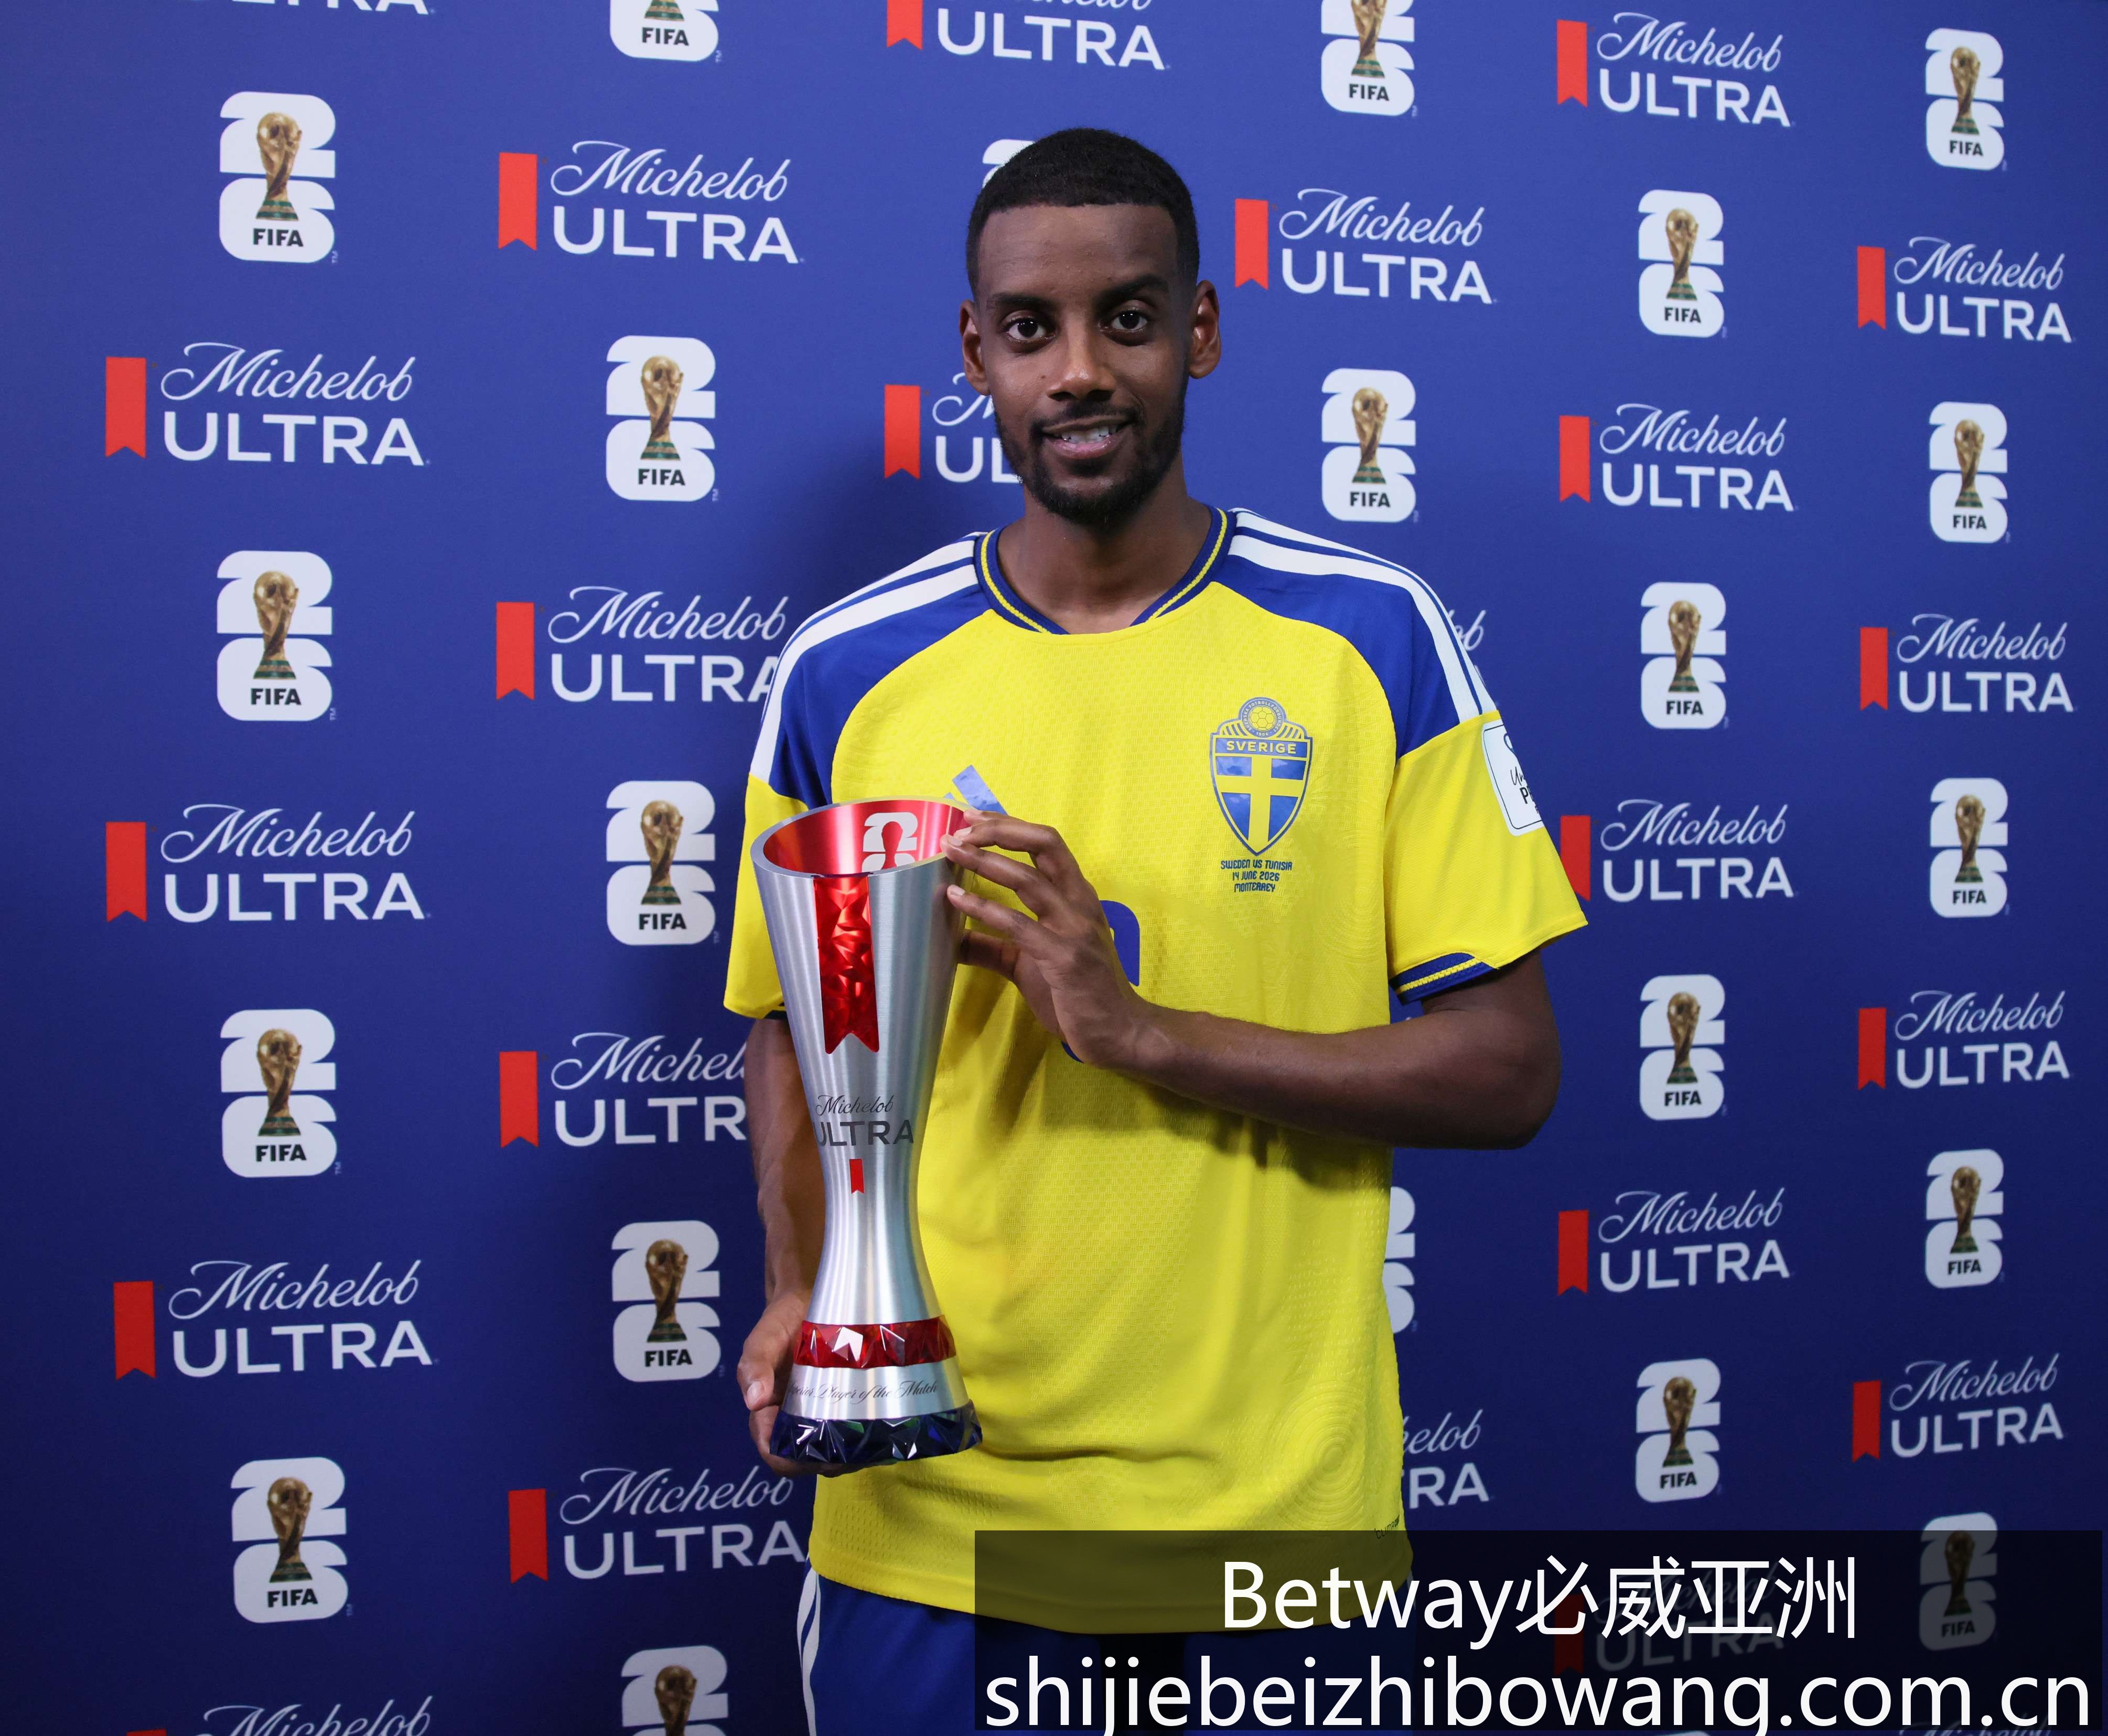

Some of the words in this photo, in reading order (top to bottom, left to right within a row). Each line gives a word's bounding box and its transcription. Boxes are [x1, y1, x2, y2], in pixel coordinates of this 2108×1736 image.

[642, 27, 689, 46] FIFA
[938, 8, 1165, 70] ULTRA
[1597, 13, 1782, 71] Michelob
[1349, 83, 1389, 101] FIFA
[1600, 69, 1790, 127] ULTRA
[551, 141, 790, 201] Michelob
[1950, 140, 1983, 156] FIFA
[253, 228, 304, 247] FIFA
[554, 206, 798, 263] ULTRA
[1279, 189, 1484, 246] Michelob
[1283, 249, 1492, 304] ULTRA
[1894, 237, 2064, 290] Michelob
[1664, 307, 1701, 323] FIFA
[1897, 292, 2071, 342] ULTRA
[161, 342, 415, 401] Michelob
[165, 412, 424, 466] ULTRA
[1600, 404, 1786, 456] Michelob
[638, 468, 685, 486] FIFA
[1350, 491, 1391, 508] FIFA
[1602, 463, 1793, 511] ULTRA
[1953, 515, 1987, 529] FIFA
[548, 586, 788, 643] Michelob
[1897, 614, 2067, 663] Michelob
[251, 688, 302, 705] FIFA
[1666, 701, 1703, 715] FIFA
[1899, 671, 2073, 712] ULTRA
[1227, 741, 1296, 754] SVERIGE
[161, 804, 415, 863] Michelob
[1601, 799, 1787, 851] Michelob
[1221, 859, 1250, 869] SWEDEN
[1265, 860, 1293, 871] TUNISIA
[1233, 872, 1239, 881] 14
[1241, 871, 1257, 880] JUNE
[1259, 871, 1279, 881] 2026
[1234, 882, 1275, 892] MONTERREY
[1604, 857, 1793, 902] ULTRA
[165, 873, 424, 923] ULTRA
[1952, 890, 1986, 904] FIFA
[639, 913, 687, 930] FIFA
[1896, 991, 2065, 1040] Michelob
[551, 1033, 746, 1090] Michel
[1897, 1041, 2069, 1088] ULTRA
[555, 1096, 746, 1146] ULTR
[815, 1095, 894, 1116] Michelob
[1664, 1090, 1702, 1107] FIFA
[256, 1144, 307, 1162] FIFA
[1599, 1188, 1784, 1242] Michelob
[169, 1260, 421, 1319] Michelob
[1601, 1240, 1789, 1292] ULTRA
[1948, 1259, 1981, 1275] FIFA
[174, 1321, 432, 1377] ULTRA
[645, 1349, 693, 1367] FIFA
[894, 1380, 938, 1398] Match
[1890, 1354, 2059, 1411] Michelob
[1891, 1403, 2063, 1457] ULTRA
[1660, 1472, 1697, 1489] FIFA
[564, 1521, 805, 1579] ULTRA
[267, 1588, 318, 1608] FIFA
